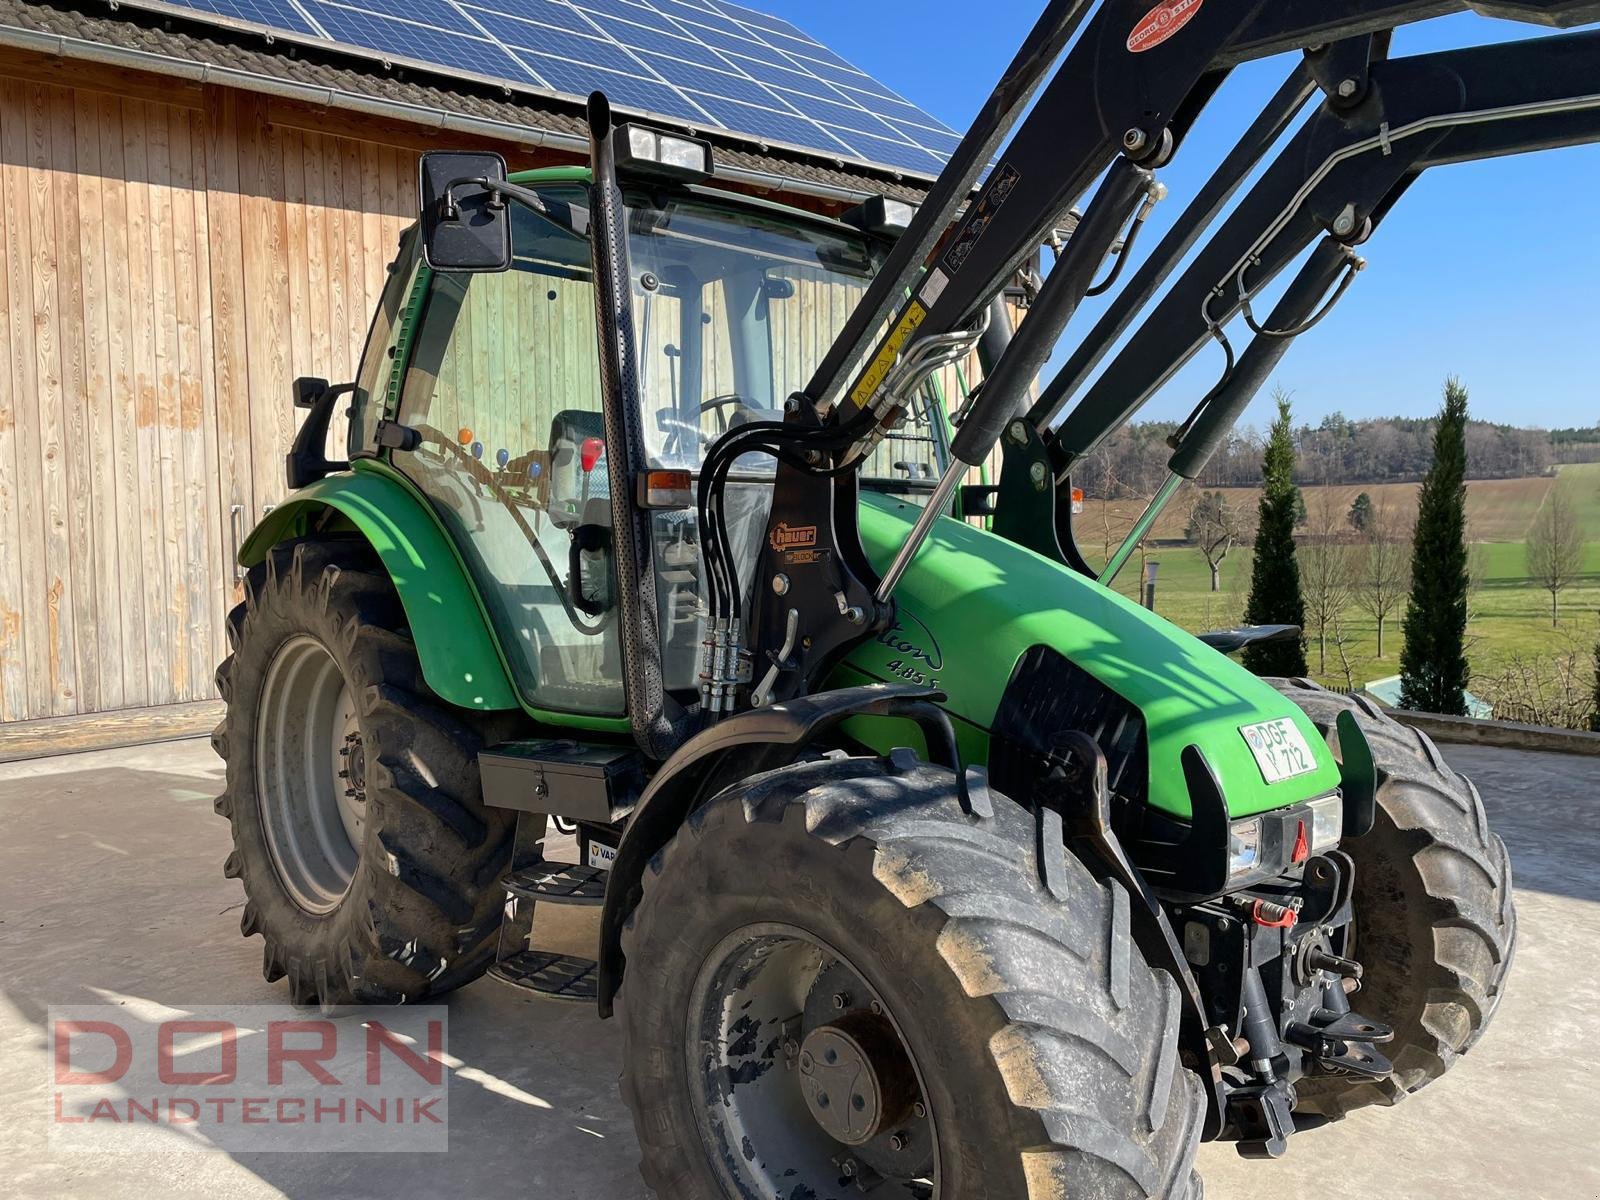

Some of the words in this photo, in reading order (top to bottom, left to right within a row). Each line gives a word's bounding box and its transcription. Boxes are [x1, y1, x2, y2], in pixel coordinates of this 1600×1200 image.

[1129, 24, 1157, 46] GEORG
[776, 528, 814, 544] hauer
[886, 660, 926, 685] 4.85
[1256, 721, 1287, 748] DGF
[1281, 746, 1309, 773] 712
[600, 848, 616, 861] VAR
